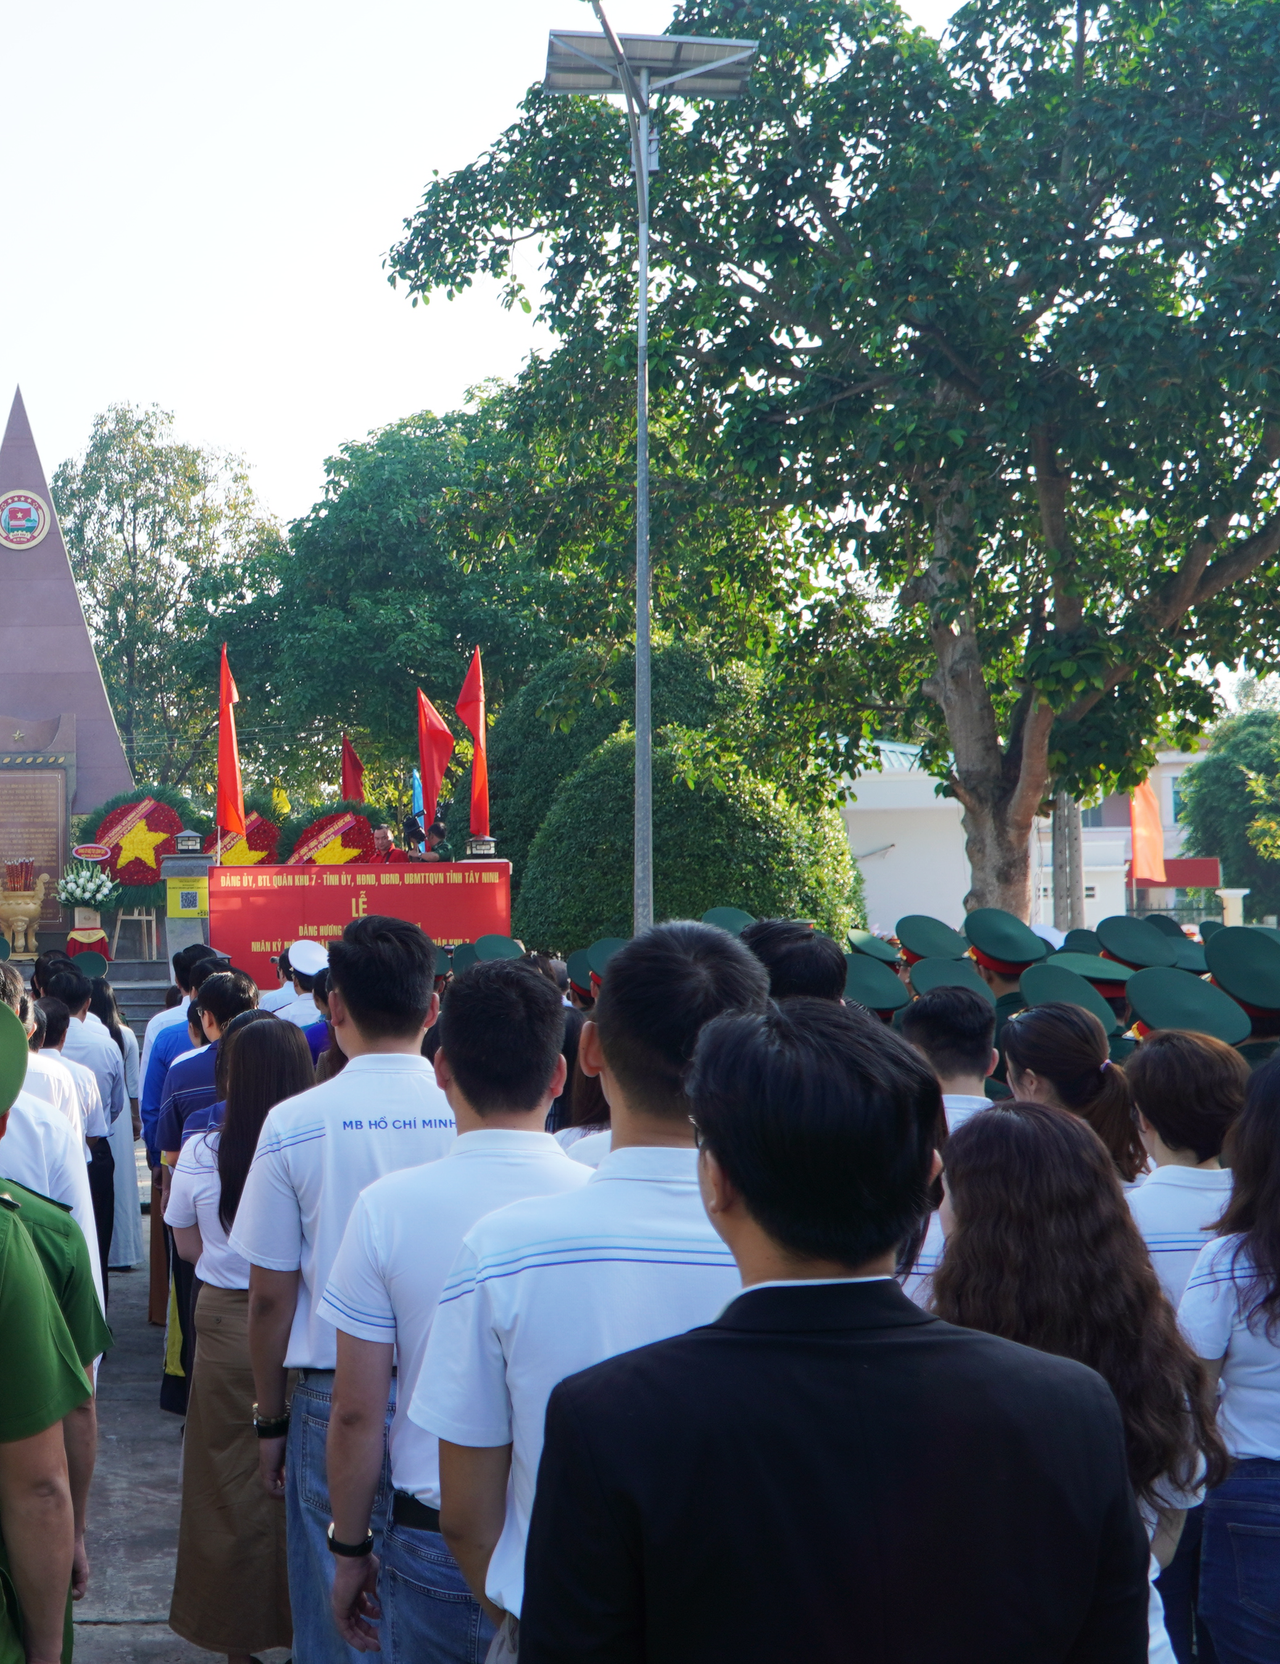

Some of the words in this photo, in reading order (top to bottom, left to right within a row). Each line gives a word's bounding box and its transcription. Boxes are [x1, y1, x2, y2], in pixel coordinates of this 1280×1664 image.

[220, 873, 240, 887] ĐẢNG
[242, 872, 256, 888] ỦY,
[258, 875, 271, 887] BTL
[273, 873, 293, 888] QUÂN
[295, 874, 309, 886] KHU
[311, 874, 316, 886] 7
[323, 872, 339, 886] TỈNH
[341, 871, 354, 887] ỦY,
[356, 874, 378, 887] HĐND,
[380, 873, 402, 886] UBND,
[404, 872, 444, 885] UBMTTQVN
[446, 870, 462, 884] TỈNH
[465, 870, 480, 883] TÂY
[482, 872, 499, 883] NINH
[351, 890, 368, 918] LỄ
[299, 924, 317, 937] DÂNG
[319, 925, 342, 937] HƯƠNG
[251, 940, 271, 952] NHÂN
[272, 938, 282, 952] KỶ
[343, 1120, 363, 1130] MB
[369, 1116, 388, 1130] HỒ
[392, 1116, 417, 1130] CHÍ
[422, 1119, 457, 1129] MINH
